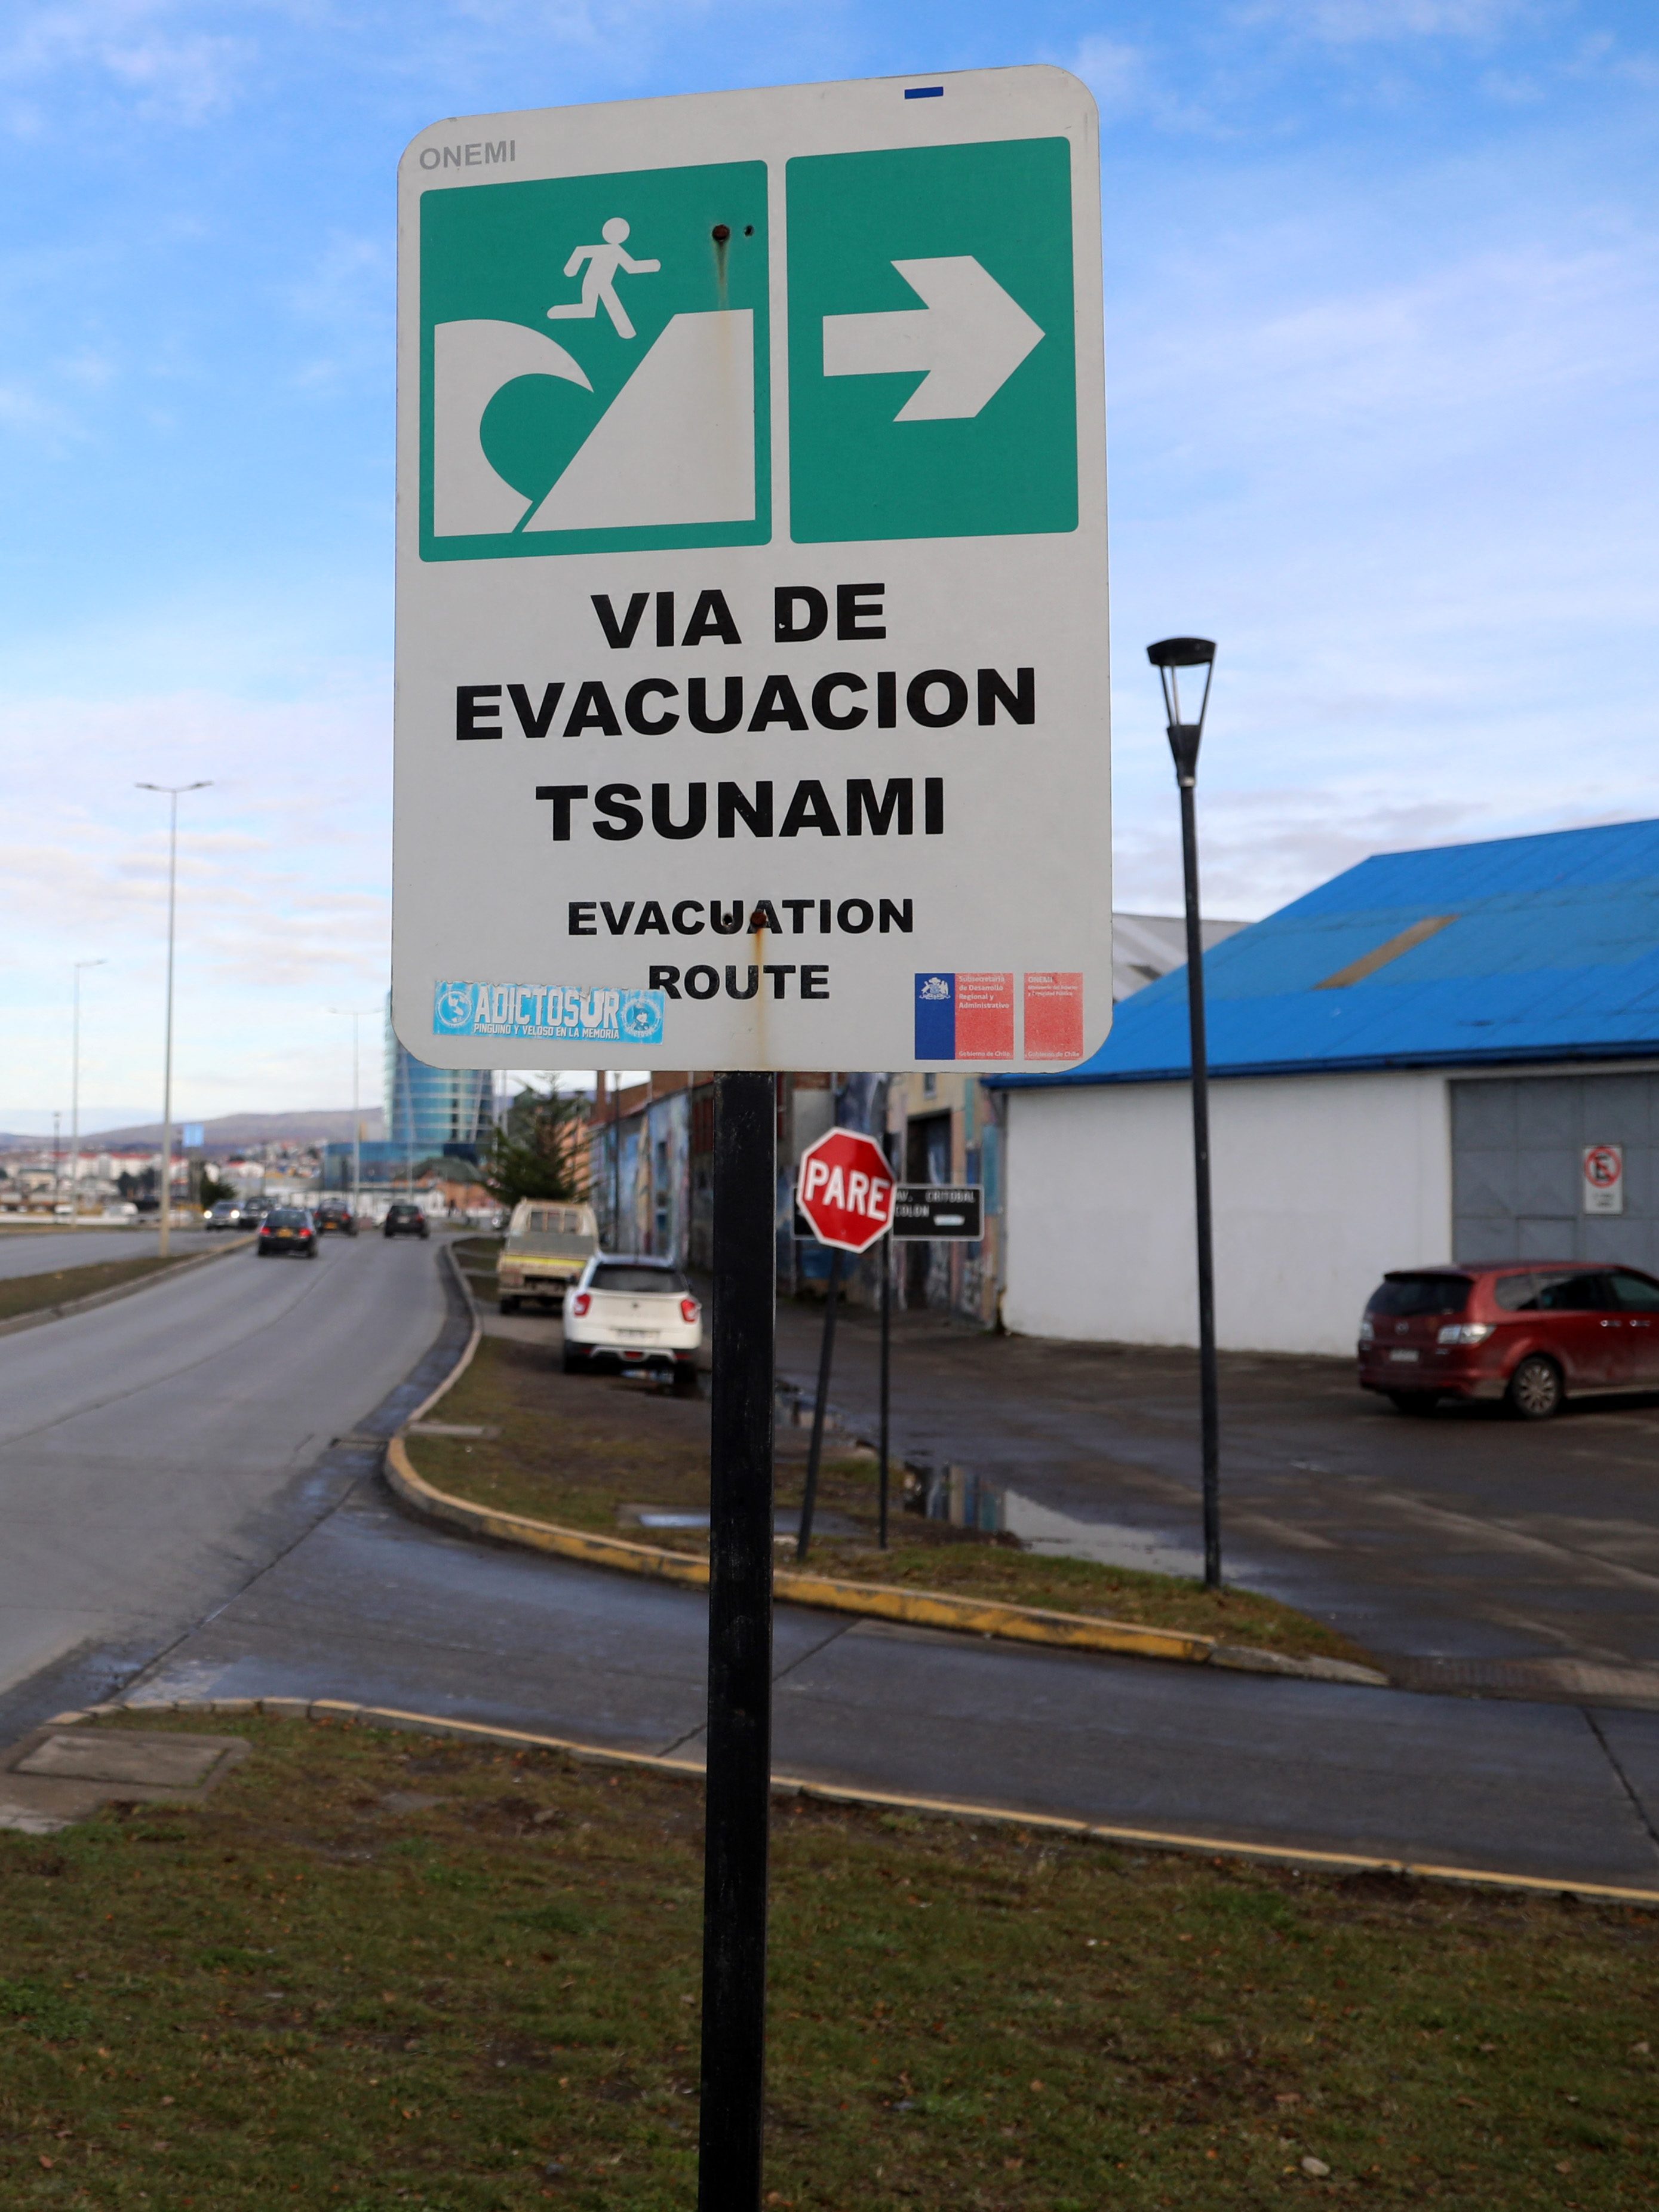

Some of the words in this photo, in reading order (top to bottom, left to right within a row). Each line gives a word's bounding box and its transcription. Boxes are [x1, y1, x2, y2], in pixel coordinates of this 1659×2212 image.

[420, 140, 516, 170] ONEMI
[591, 589, 742, 649] VIA
[775, 583, 886, 643] DE
[457, 668, 1035, 740] EVACUACION
[536, 778, 944, 841] TSUNAMI
[569, 898, 913, 936] EVACUATION
[649, 964, 830, 1000] ROUTE
[474, 985, 620, 1030] ADICTOSUR
[474, 1023, 511, 1035] PINGUINO
[514, 1025, 520, 1035] Y
[523, 1026, 554, 1037] VELOSO
[556, 1027, 567, 1037] EN
[569, 1028, 579, 1038] LA
[582, 1028, 619, 1040] MEMORIA
[805, 1159, 890, 1221] PARE
